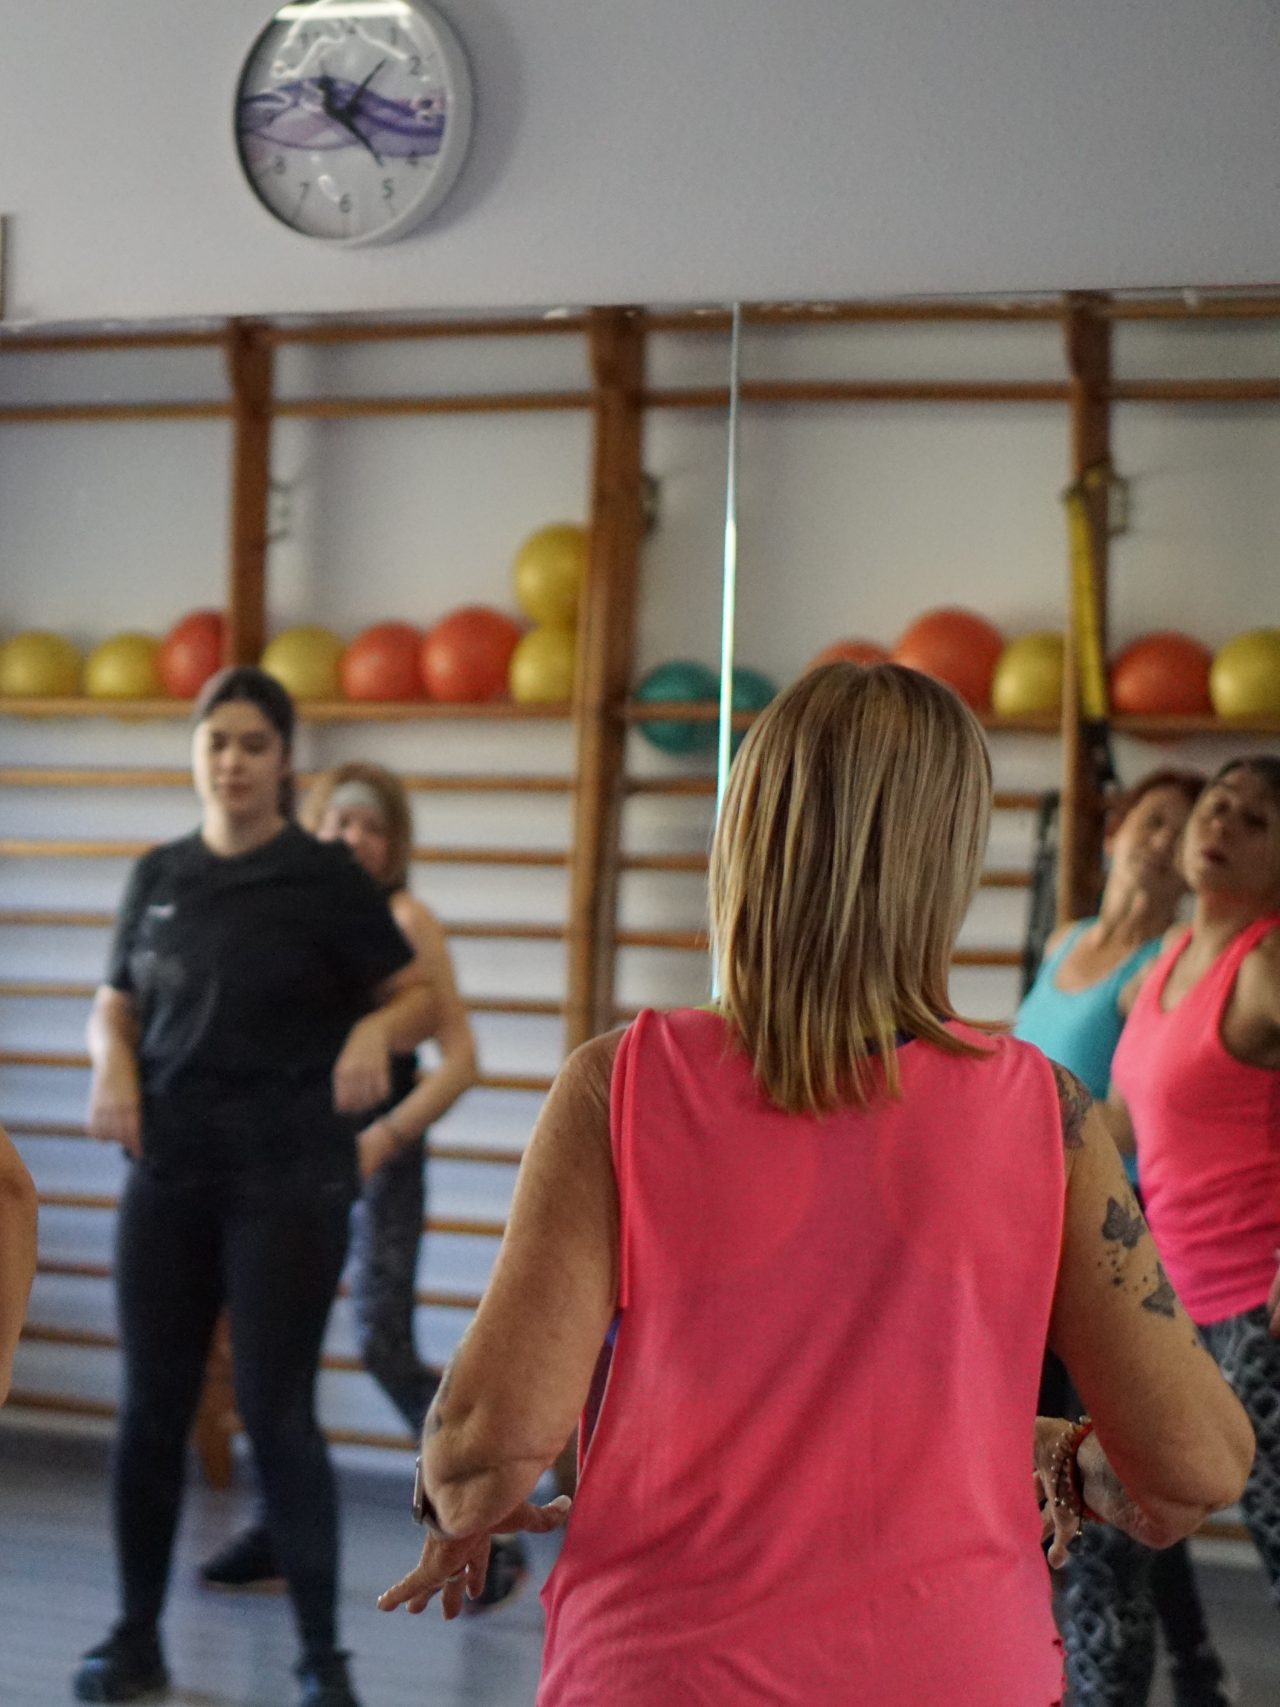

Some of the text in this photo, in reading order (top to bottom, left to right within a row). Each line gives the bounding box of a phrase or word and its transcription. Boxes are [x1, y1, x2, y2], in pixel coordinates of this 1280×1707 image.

[409, 55, 421, 76] 2
[382, 177, 394, 199] 5
[339, 193, 351, 213] 6
